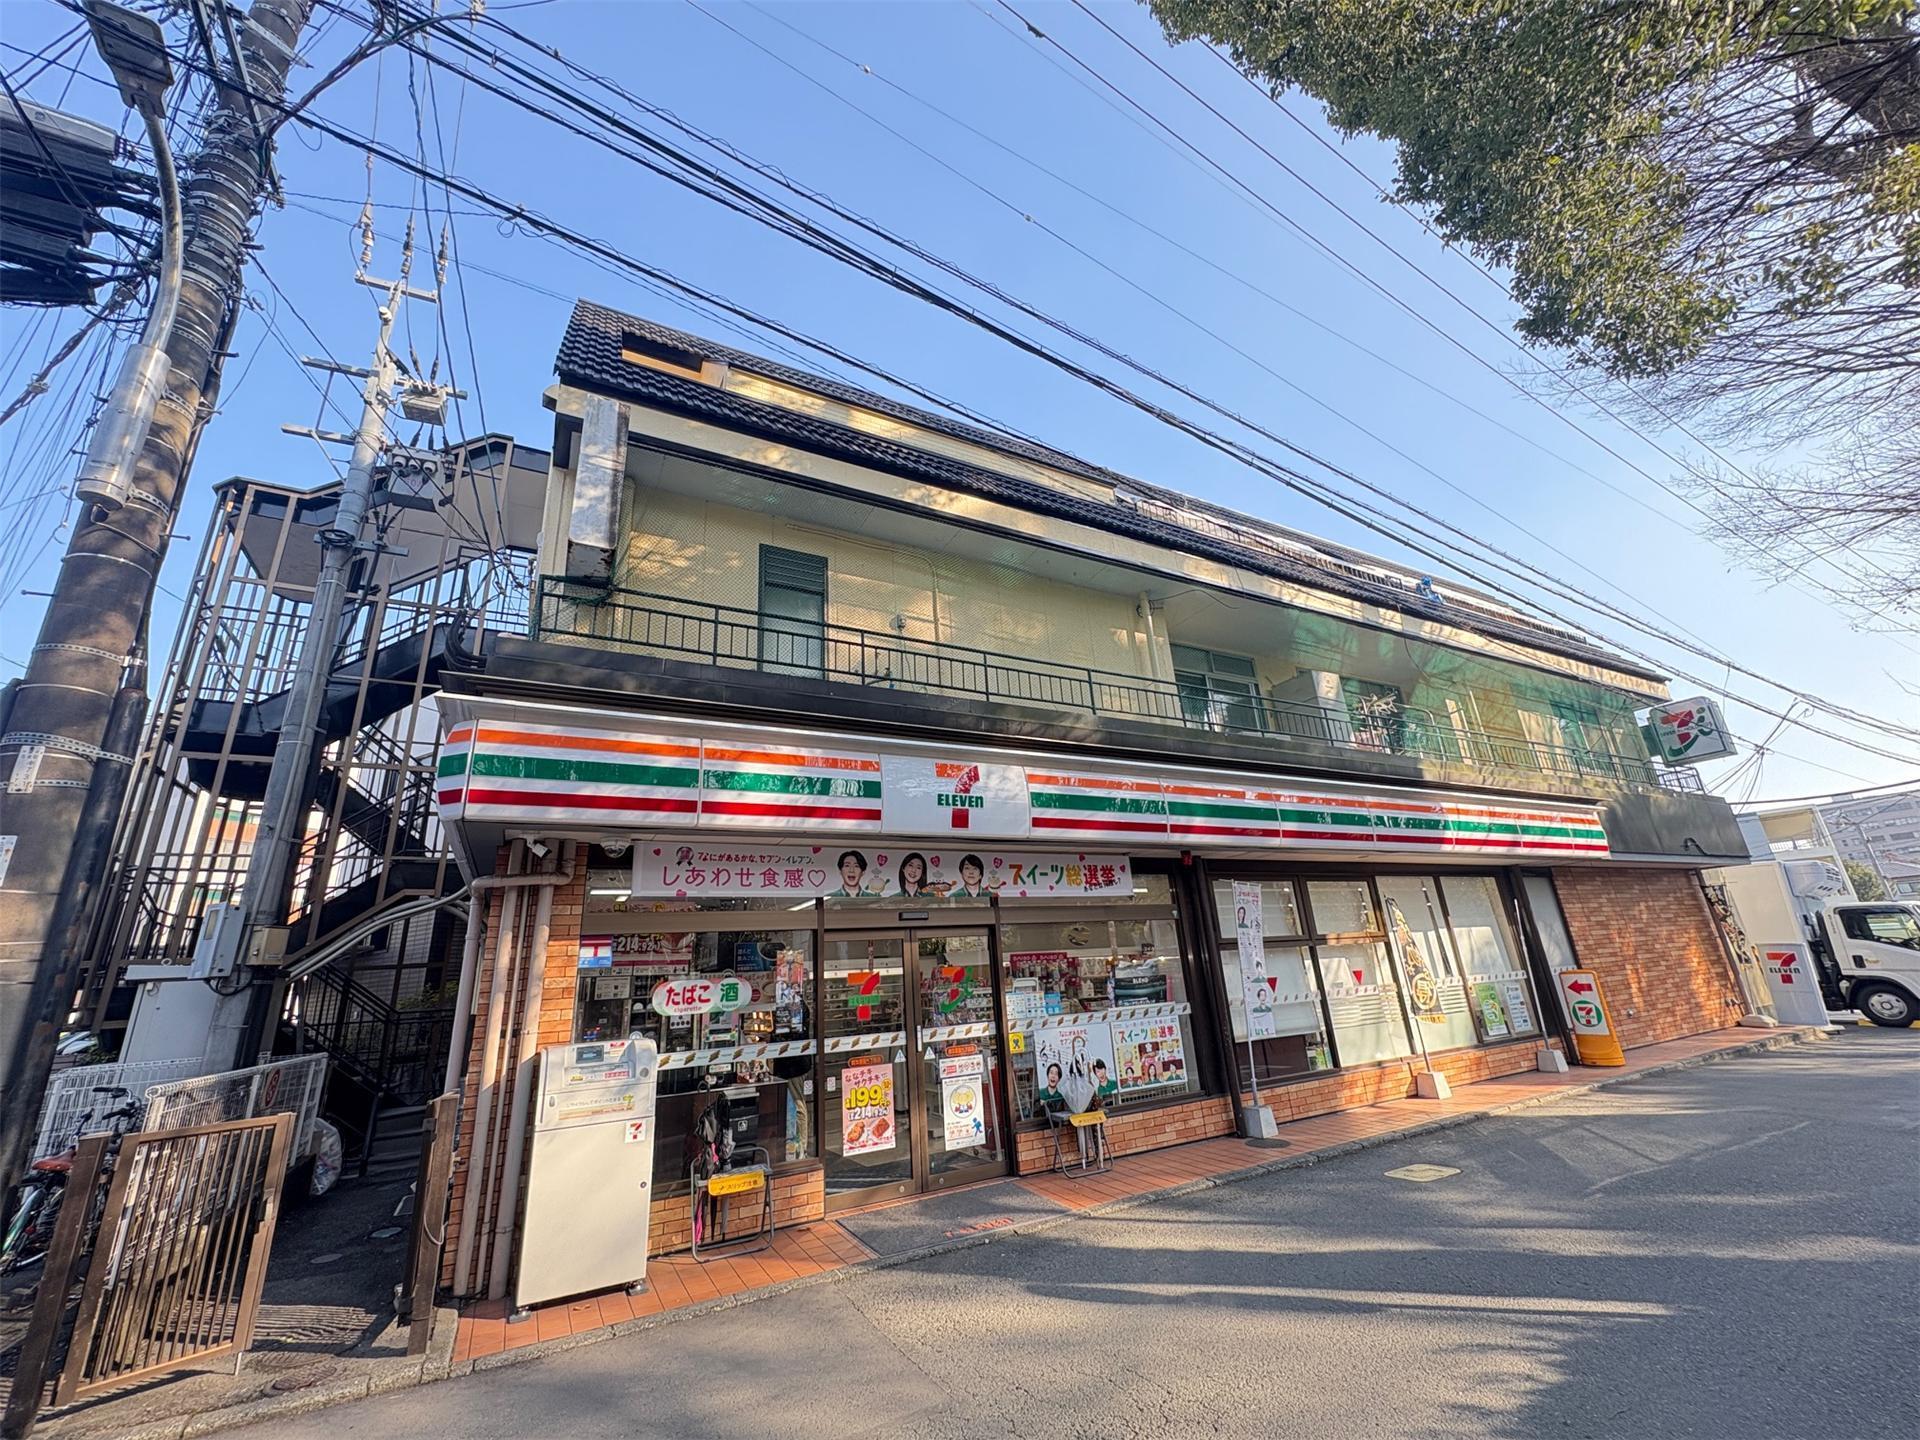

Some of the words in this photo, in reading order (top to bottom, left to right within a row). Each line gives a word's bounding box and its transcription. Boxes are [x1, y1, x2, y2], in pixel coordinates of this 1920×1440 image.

[935, 762, 980, 828] 7
[662, 866, 805, 888] しあわせ食感
[1008, 863, 1115, 887] スイーツ総選挙
[665, 984, 711, 1007] たばこ
[720, 982, 740, 1003] 酒
